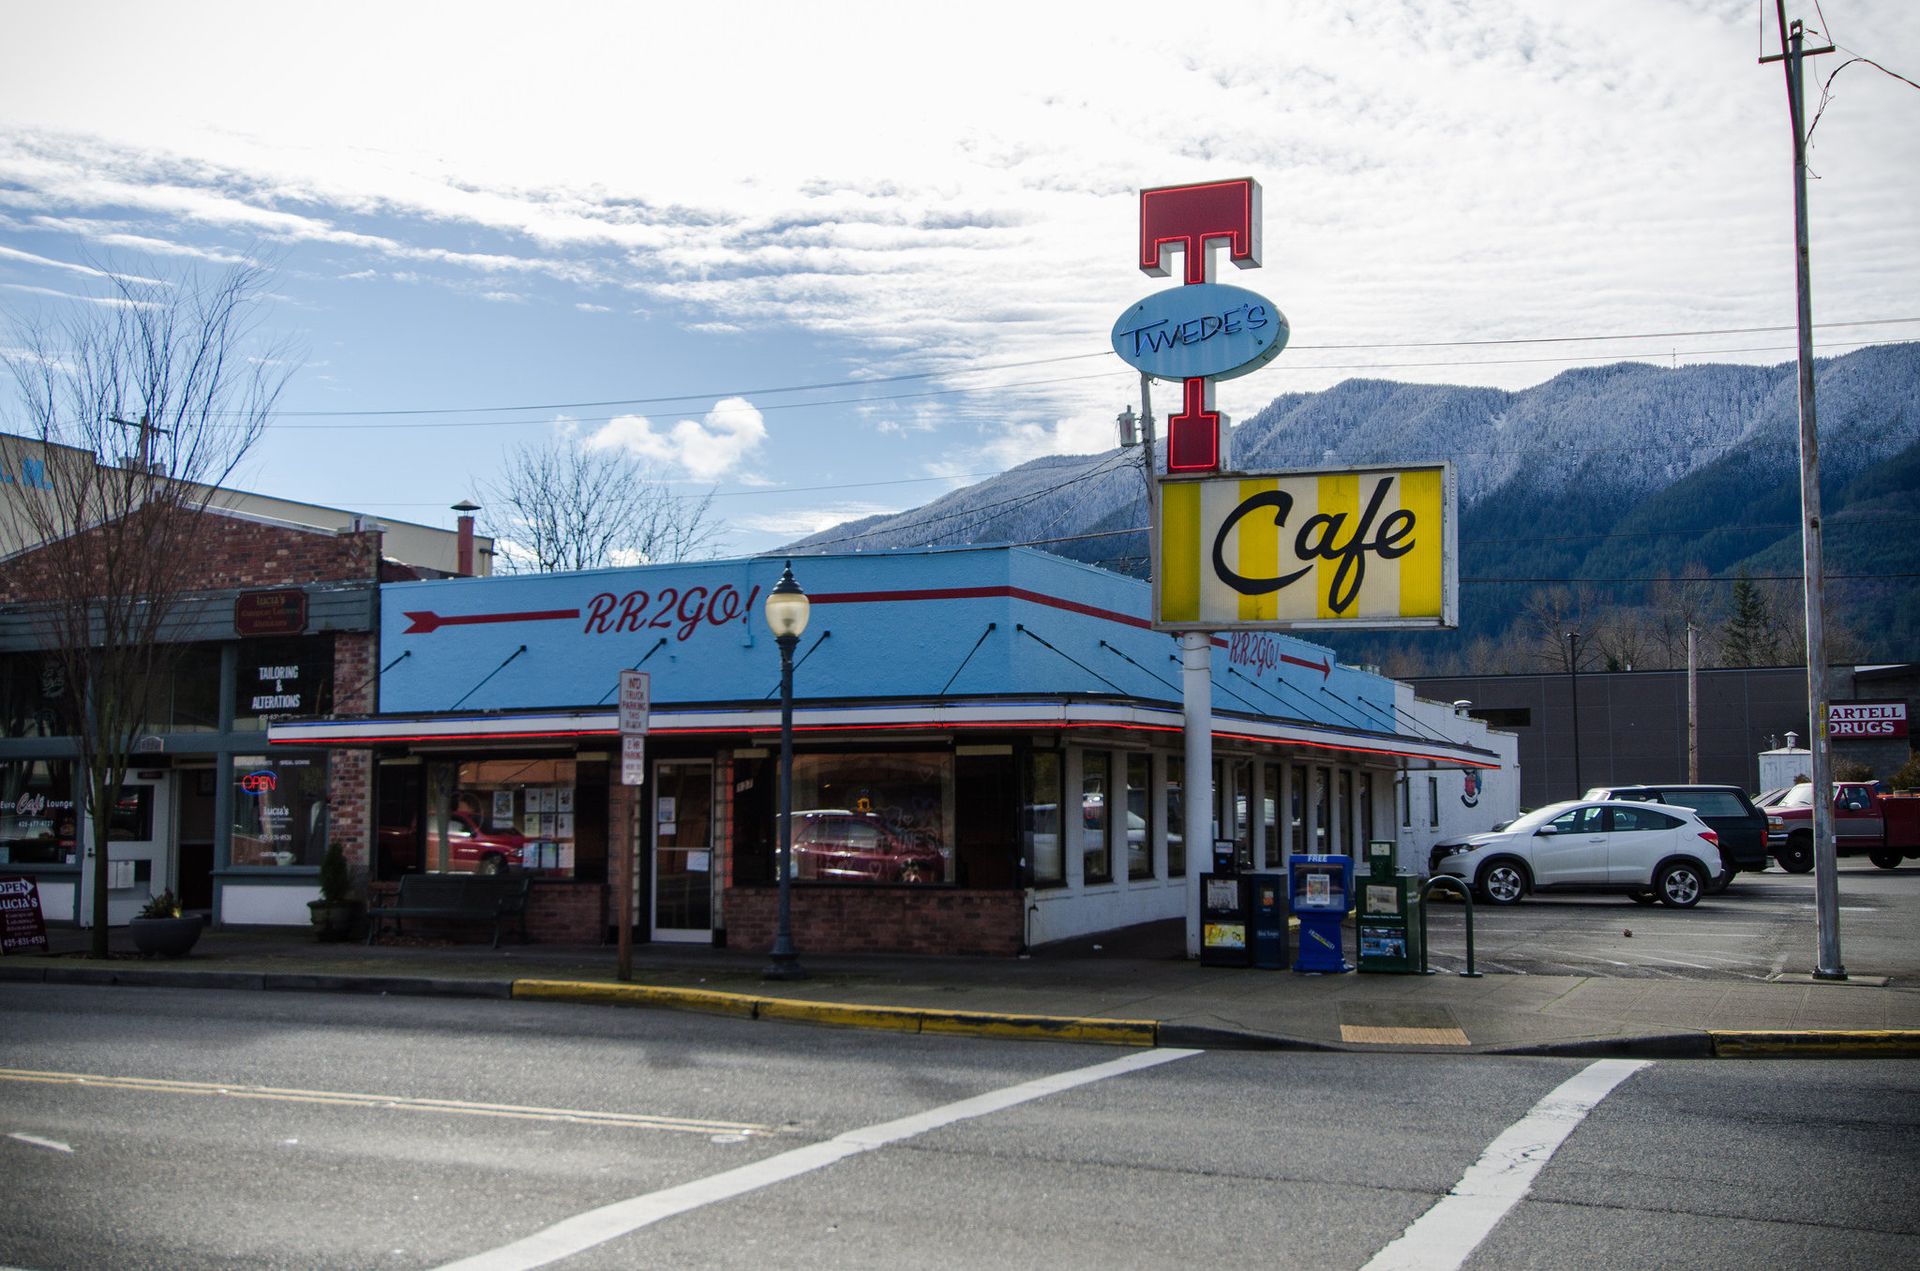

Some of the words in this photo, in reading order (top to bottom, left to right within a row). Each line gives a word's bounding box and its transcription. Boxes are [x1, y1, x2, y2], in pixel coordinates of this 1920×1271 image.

[1119, 303, 1268, 357] TWEDE'S
[1212, 476, 1417, 614] Cafe
[584, 584, 761, 641] RR2GO!
[1229, 632, 1280, 677] RR2GO!
[258, 665, 300, 680] TAILORING
[276, 679, 283, 692] &
[629, 678, 641, 689] NO
[252, 693, 301, 710] ALTERATIONS
[625, 690, 644, 700] TRUCK
[622, 701, 647, 711] PARKING
[1830, 707, 1901, 719] ARTELL
[1829, 721, 1895, 734] DRUGS
[242, 775, 277, 792] OPEN
[0, 800, 16, 809] Euro
[46, 800, 73, 809] Lounge
[1307, 855, 1328, 863] FREE
[0, 882, 29, 893] OPEN
